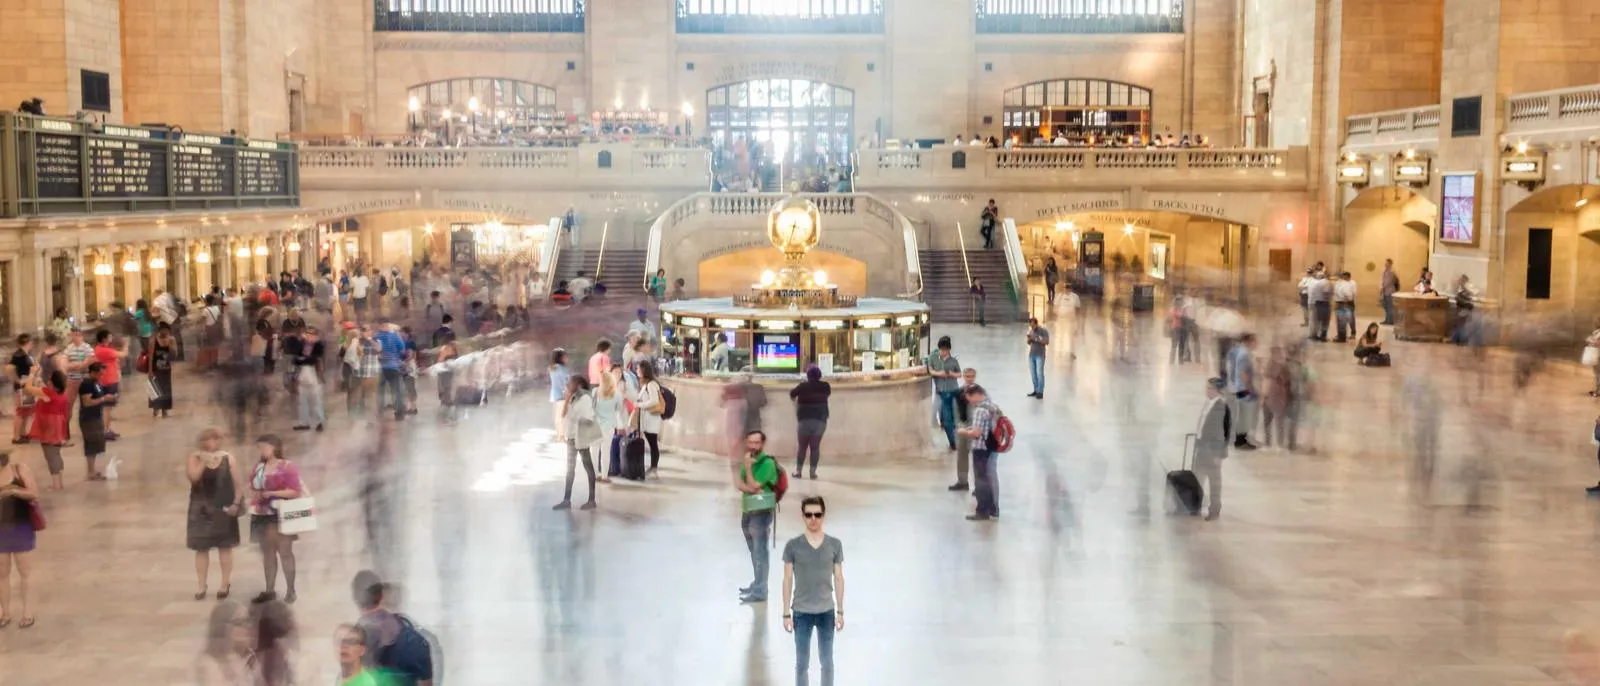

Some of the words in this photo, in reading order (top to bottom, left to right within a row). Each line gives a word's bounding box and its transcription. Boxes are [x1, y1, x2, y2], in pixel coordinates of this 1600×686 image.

[319, 203, 356, 217] TICKET
[358, 198, 411, 209] MACHINES
[443, 198, 480, 209] SUBWAY
[1036, 205, 1069, 218] TICKET
[1071, 199, 1120, 210] MACHINES
[1152, 199, 1189, 209] TRACKS
